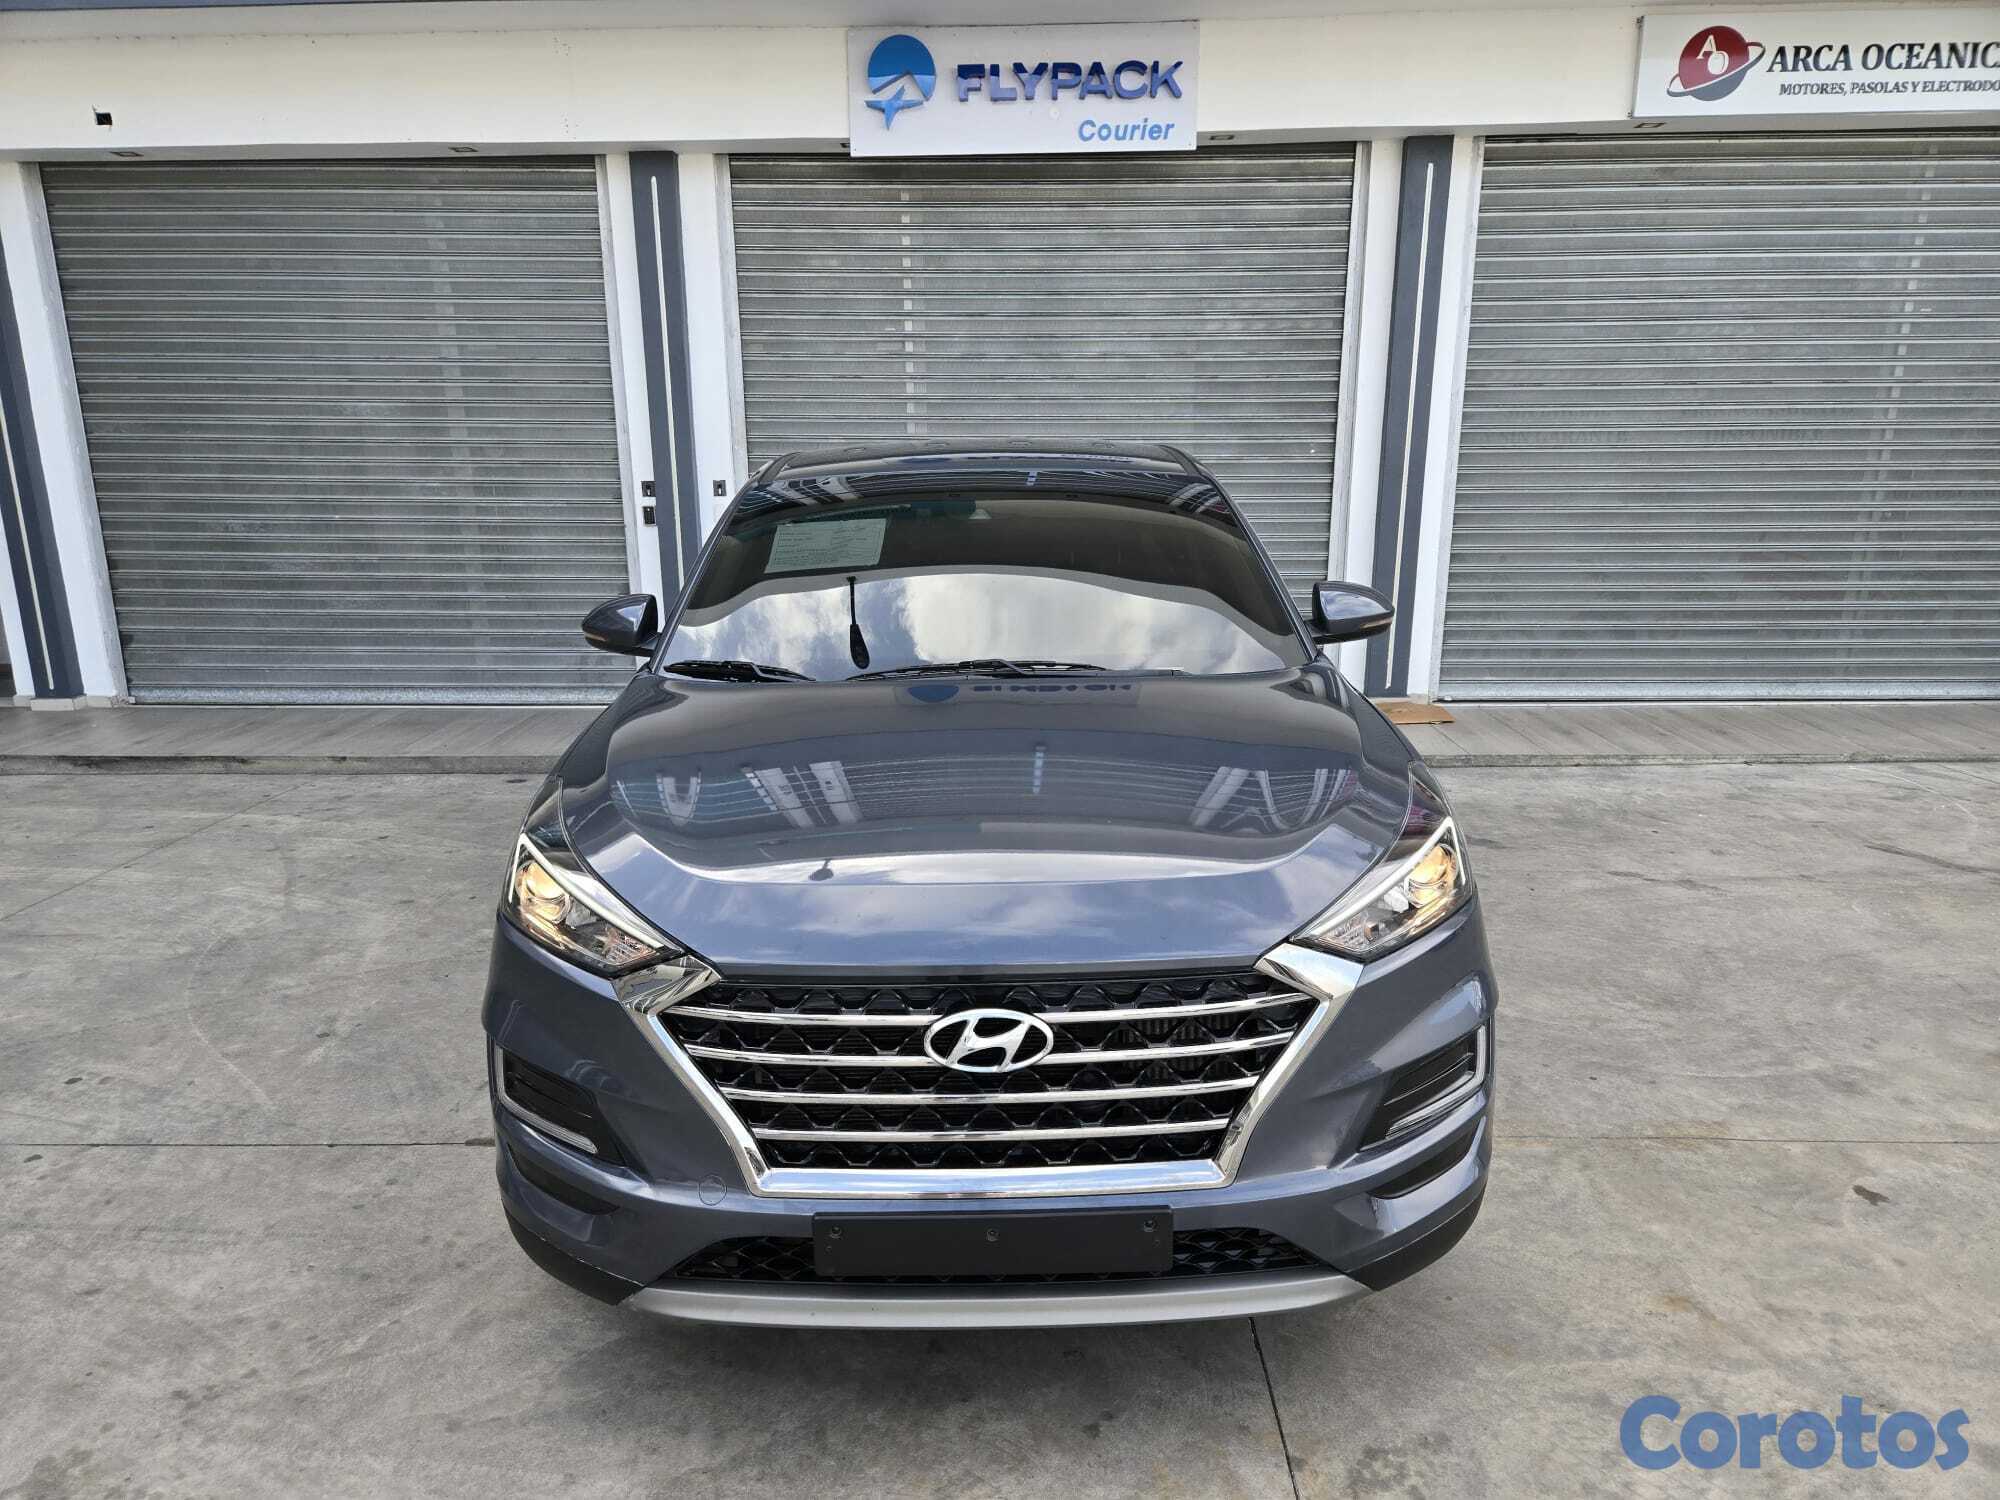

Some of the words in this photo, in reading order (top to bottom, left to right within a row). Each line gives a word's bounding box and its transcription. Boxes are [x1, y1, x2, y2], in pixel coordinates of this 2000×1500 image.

[1766, 44, 1853, 72] ARCA
[1861, 41, 2000, 70] OCEANIC
[957, 60, 1183, 102] FLYPACK
[1779, 82, 1847, 96] MOTORES,
[1850, 80, 1909, 94] PASOLAS
[1911, 80, 1920, 93] Y
[1921, 79, 2000, 93] ELECTRODO
[1078, 117, 1175, 142] Courier
